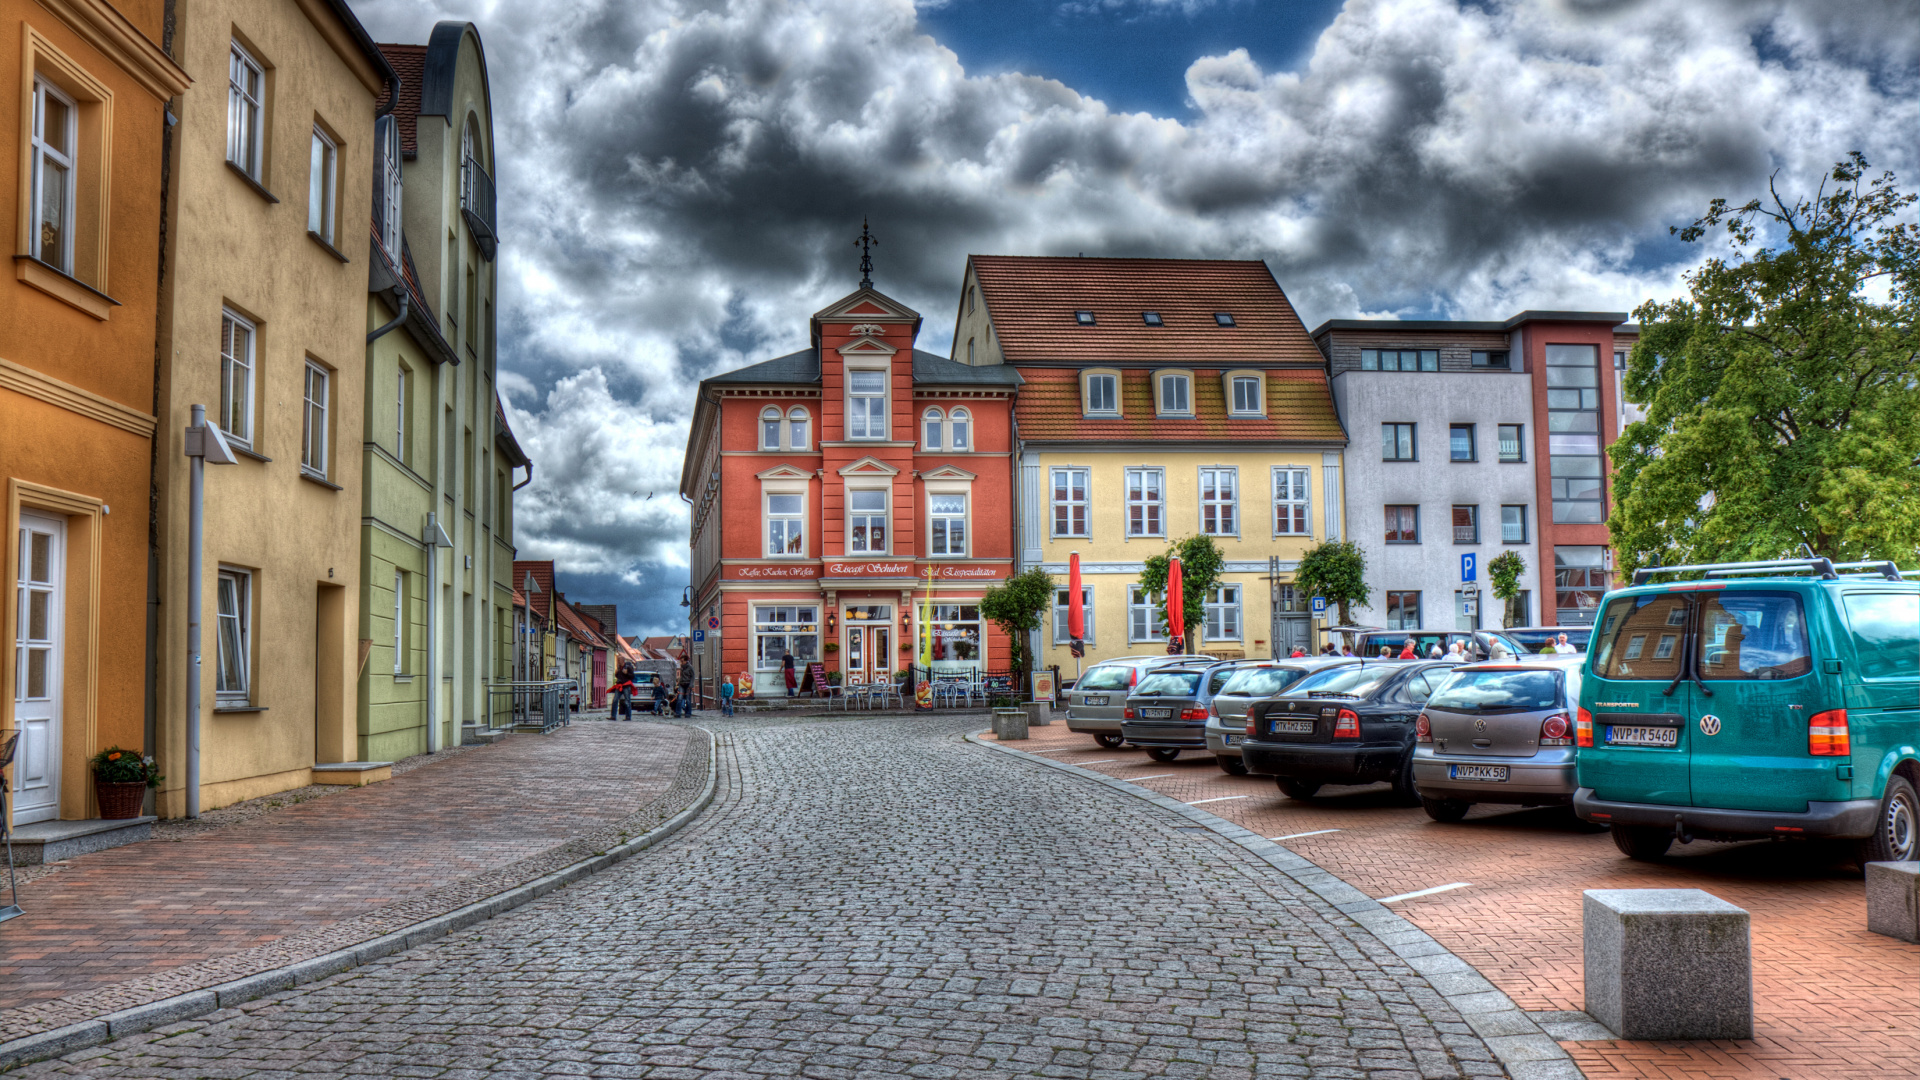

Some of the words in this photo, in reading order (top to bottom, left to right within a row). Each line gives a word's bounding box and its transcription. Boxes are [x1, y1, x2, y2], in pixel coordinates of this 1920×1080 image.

[789, 567, 814, 577] Waffeln
[830, 563, 866, 575] Eiscafé
[867, 563, 908, 573] Schubert
[1464, 557, 1473, 578] P
[695, 631, 703, 641] P
[1300, 722, 1312, 731] 555
[1613, 727, 1632, 740] NVP
[1640, 728, 1647, 741] R
[1648, 729, 1676, 742] 5460
[1456, 766, 1474, 776] NVP
[1479, 767, 1492, 777] KK
[1493, 768, 1506, 778] 58
